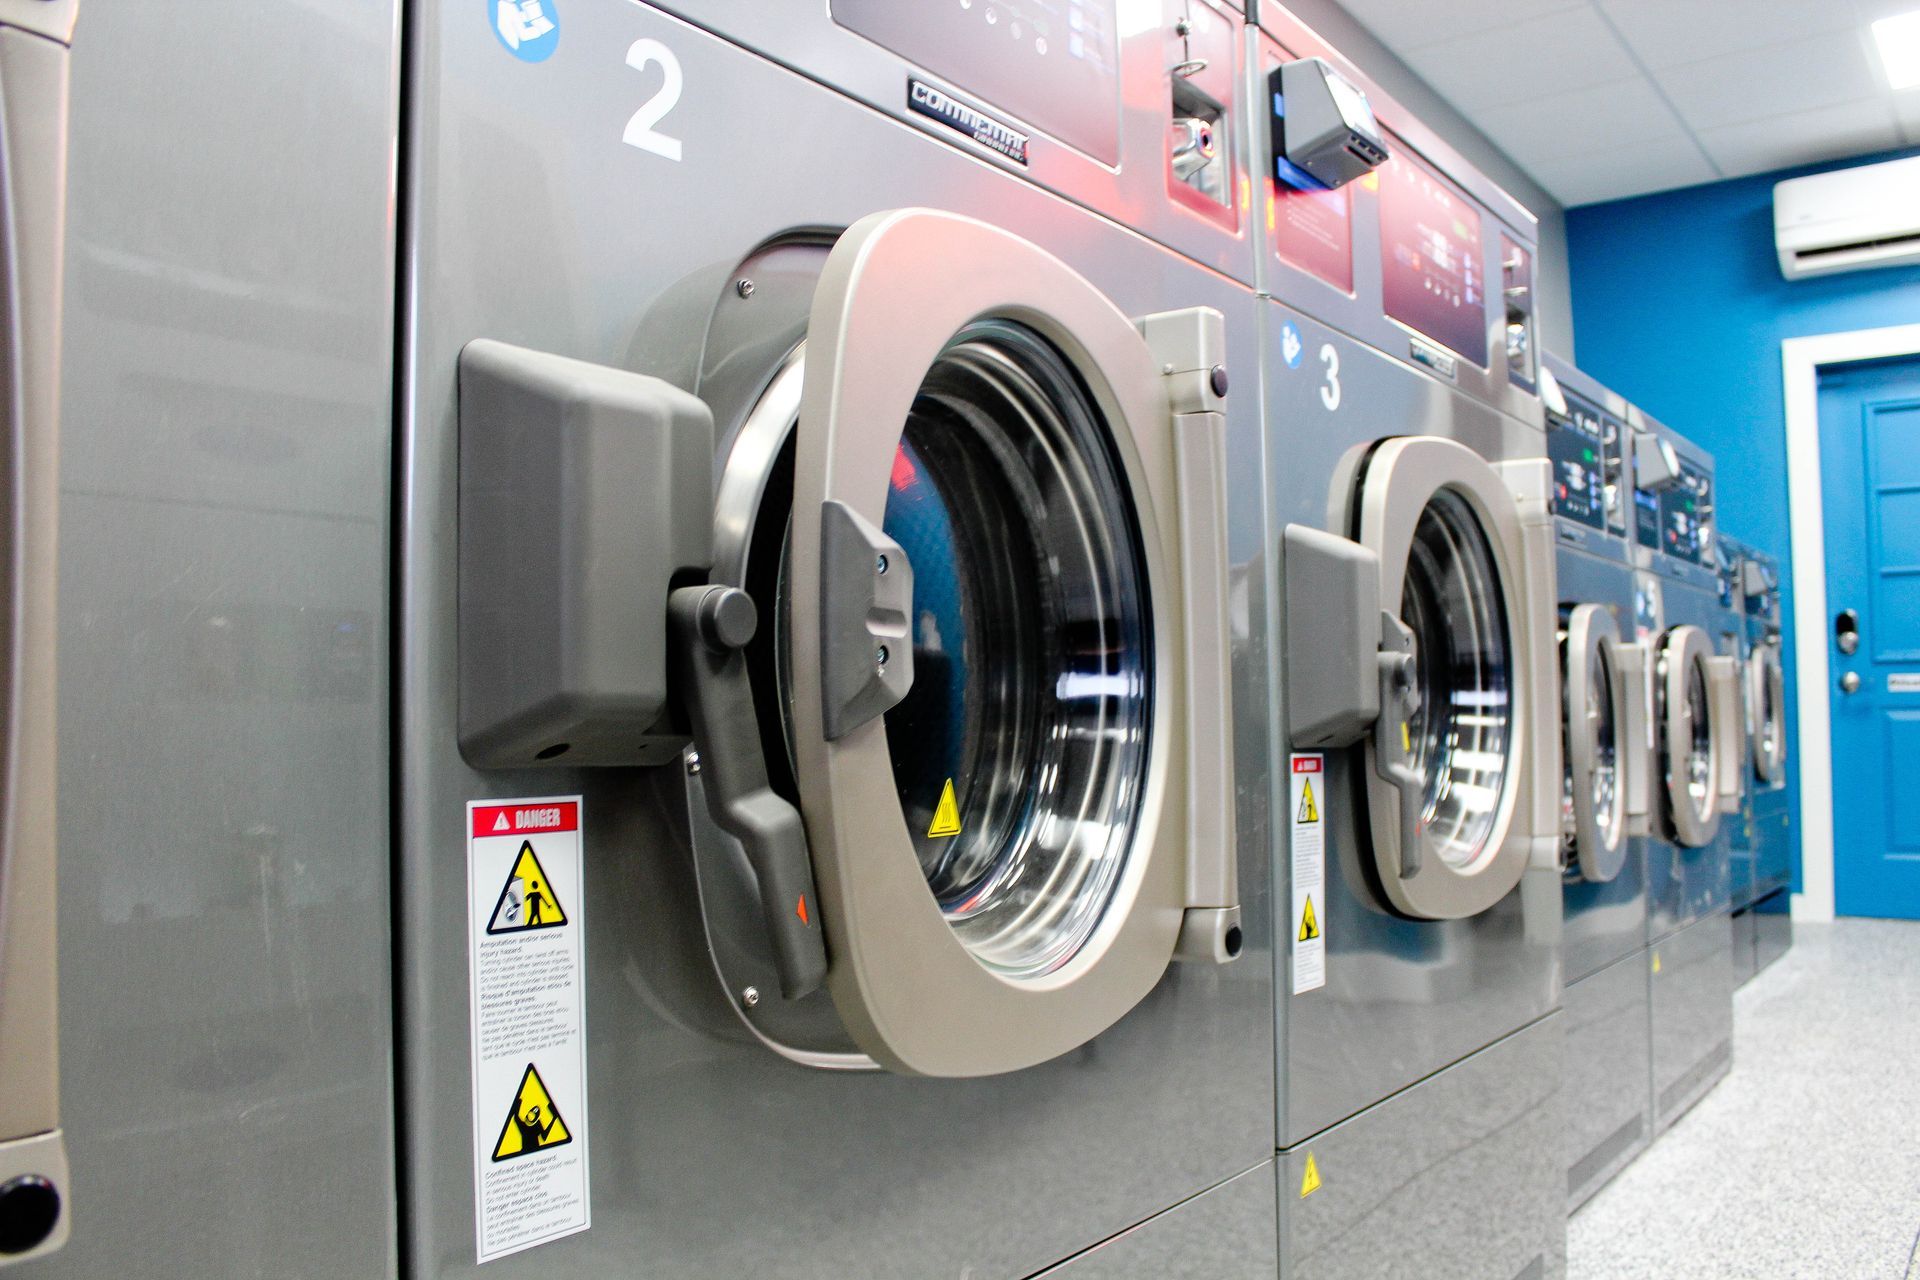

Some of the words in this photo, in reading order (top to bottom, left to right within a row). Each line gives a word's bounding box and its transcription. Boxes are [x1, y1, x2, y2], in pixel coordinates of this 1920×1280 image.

[622, 37, 684, 163] 2
[1319, 343, 1342, 412] 3
[515, 808, 561, 829] DANGER
